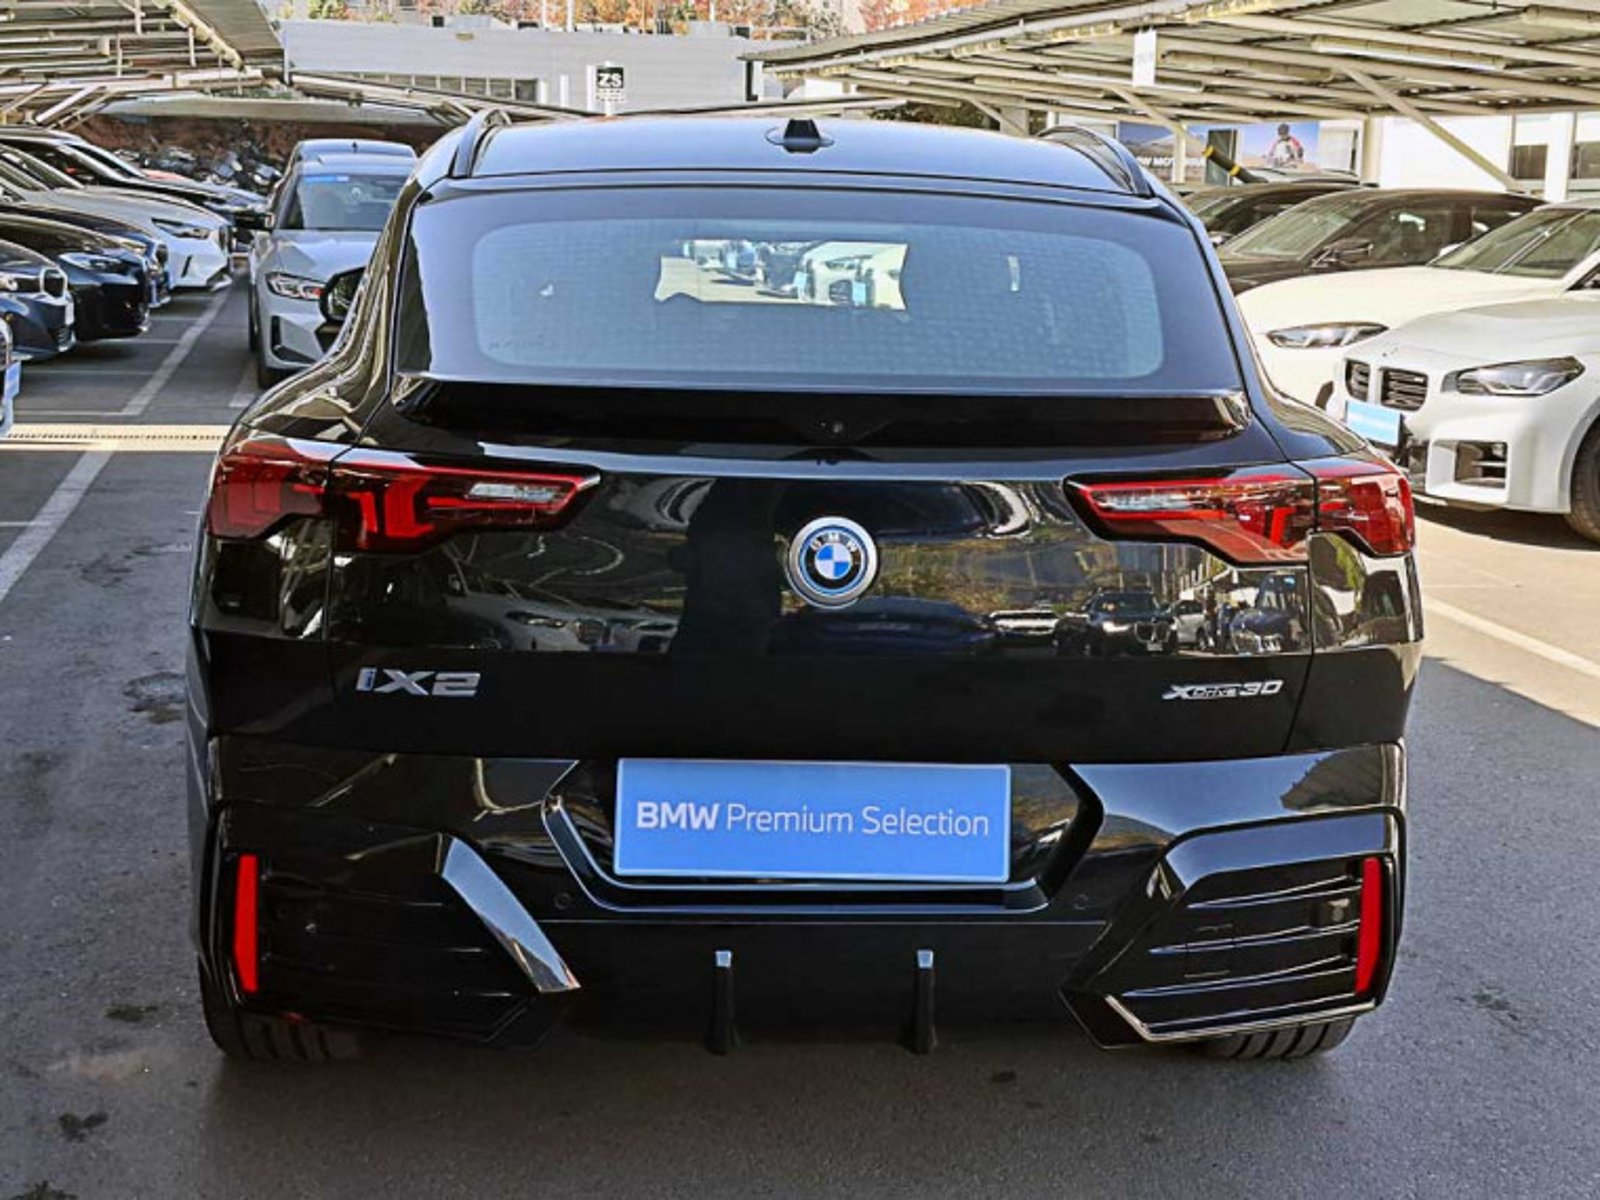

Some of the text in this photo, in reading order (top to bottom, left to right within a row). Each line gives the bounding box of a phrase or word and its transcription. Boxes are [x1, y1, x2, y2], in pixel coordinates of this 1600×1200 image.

[810, 532, 857, 553] BMW
[636, 801, 989, 837] BMW Premium Selection
